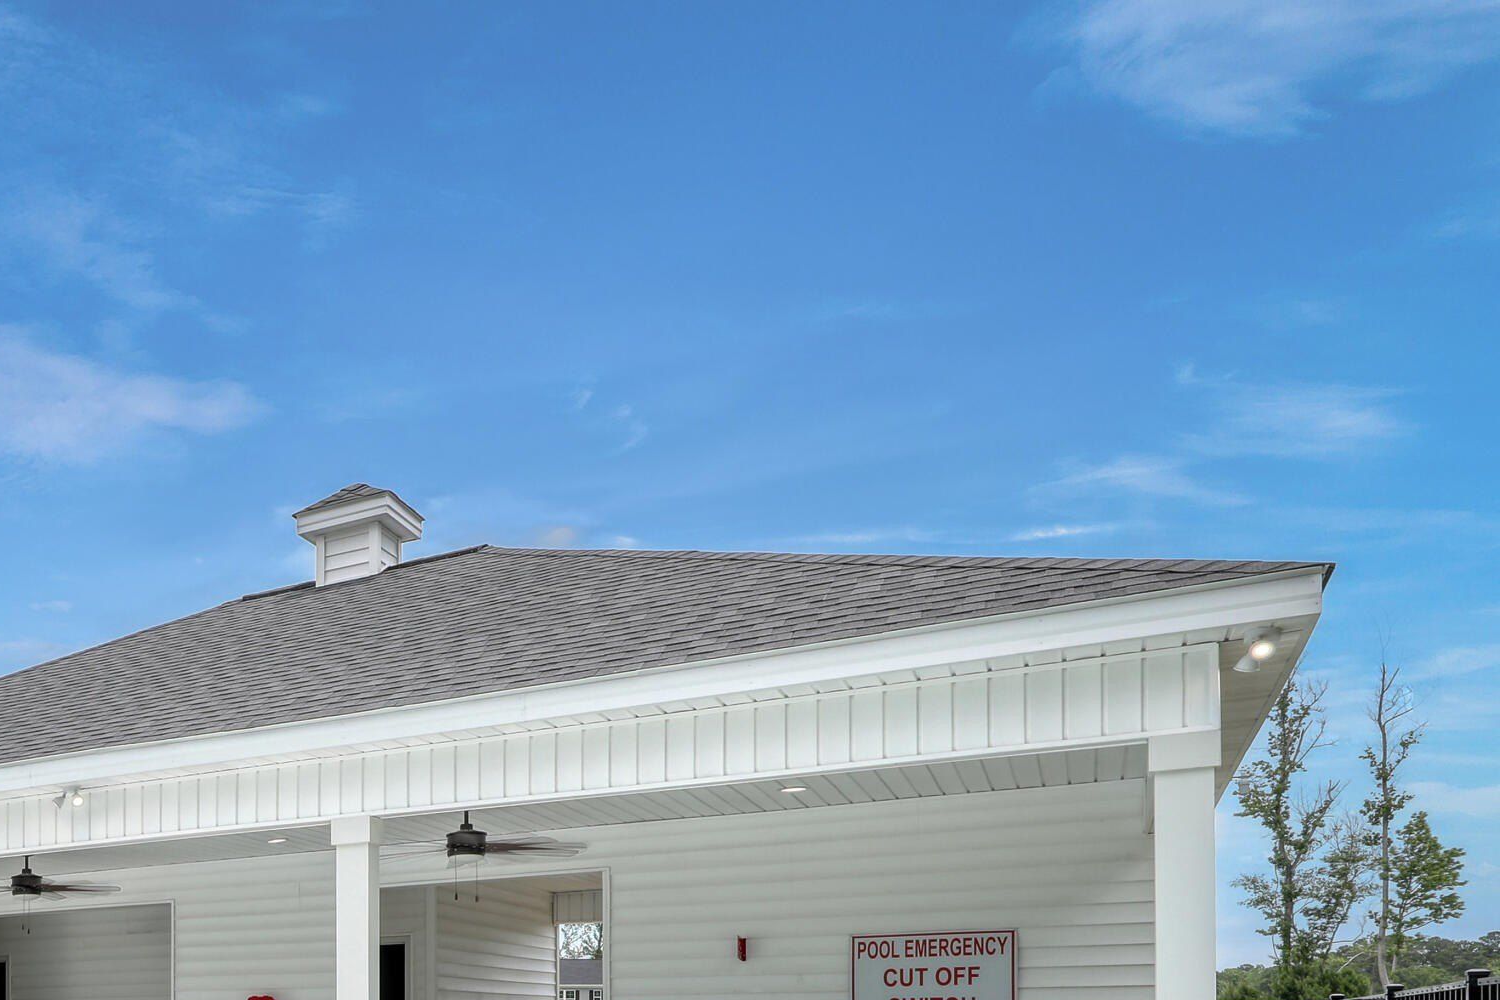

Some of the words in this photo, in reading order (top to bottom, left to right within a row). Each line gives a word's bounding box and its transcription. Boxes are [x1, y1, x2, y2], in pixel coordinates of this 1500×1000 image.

[857, 940, 900, 959] POOL
[905, 936, 1008, 958] EMERGENCY
[883, 967, 928, 987] CUT
[935, 966, 980, 986] OFF
